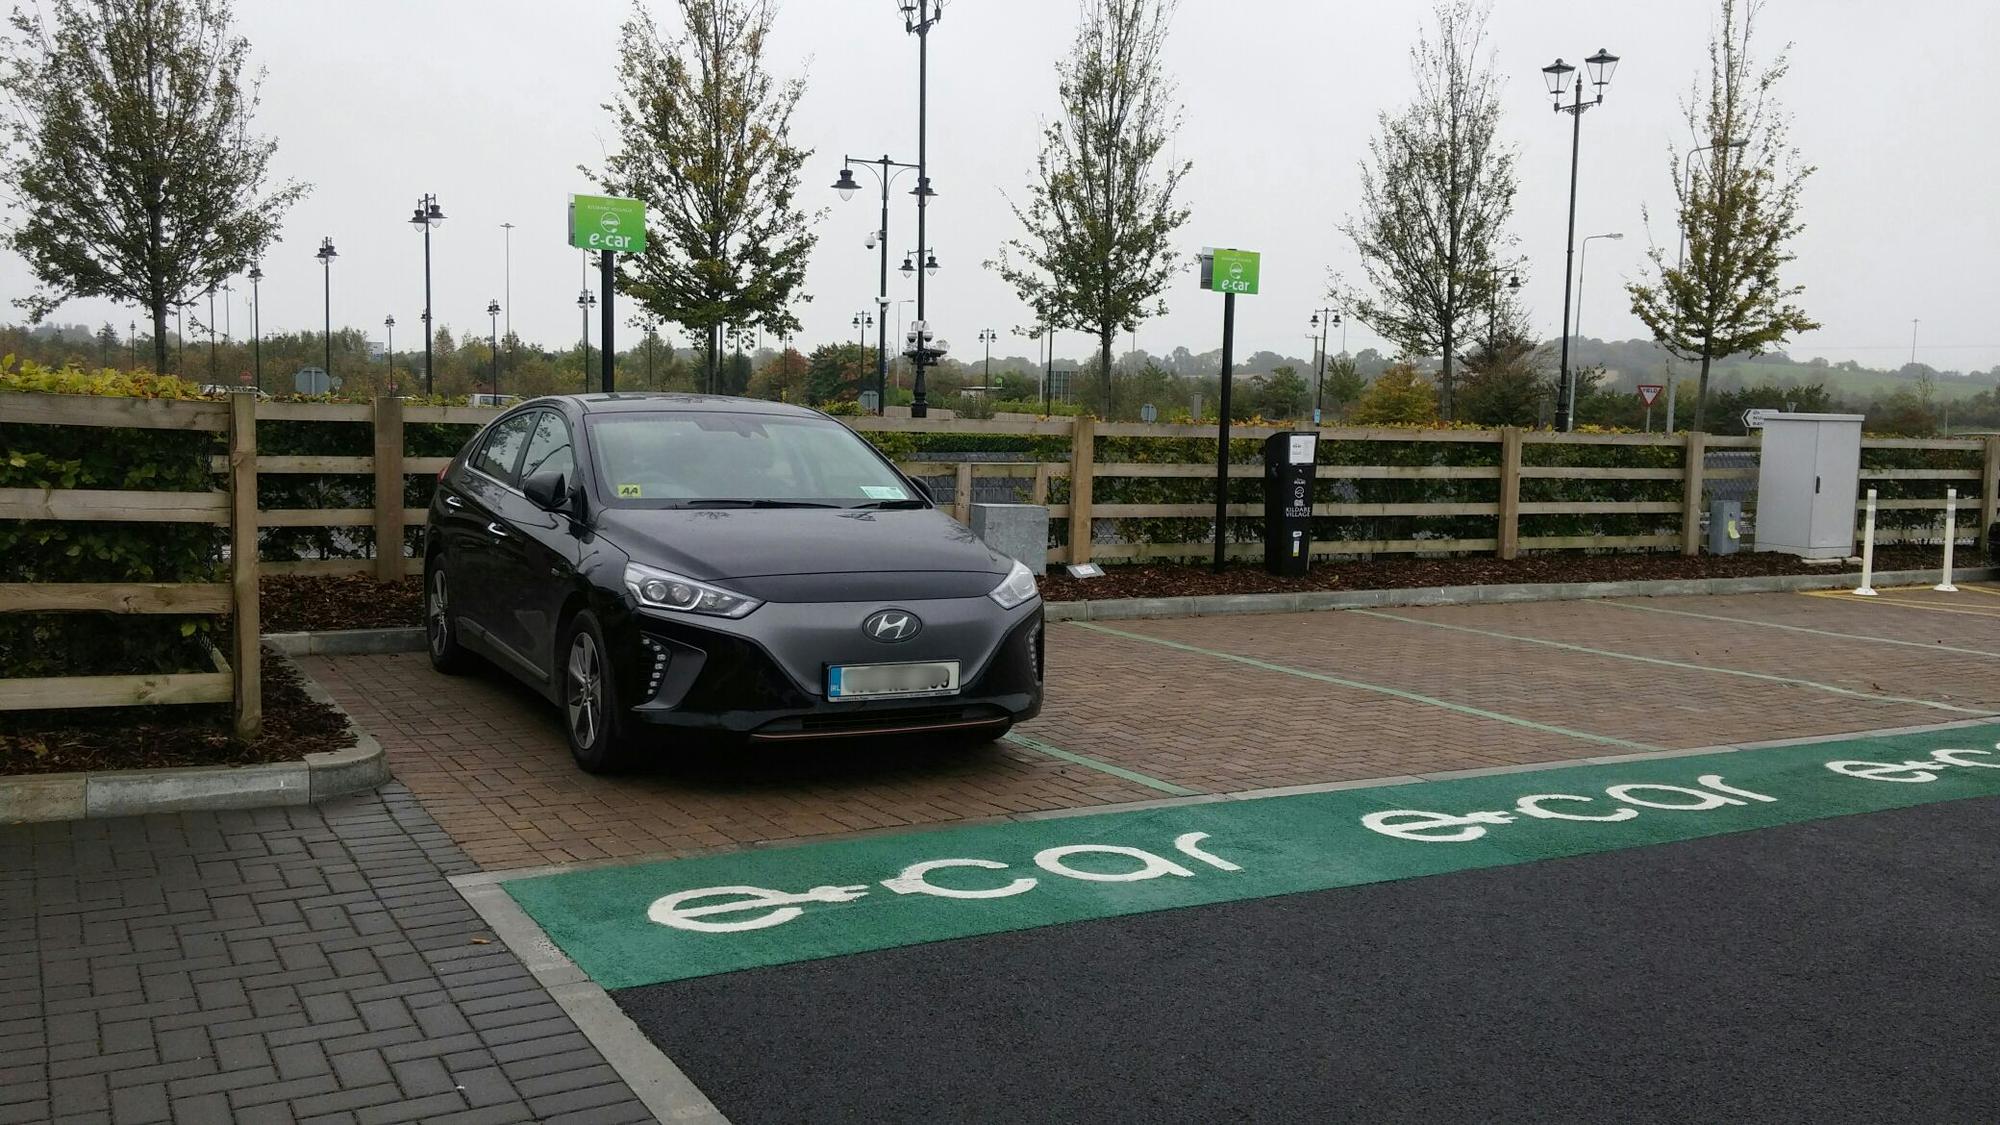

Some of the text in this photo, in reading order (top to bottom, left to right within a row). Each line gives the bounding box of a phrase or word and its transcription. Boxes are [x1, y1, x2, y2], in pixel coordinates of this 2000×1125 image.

[589, 233, 631, 248] e-car
[1222, 280, 1249, 291] e-car
[621, 487, 638, 495] AA
